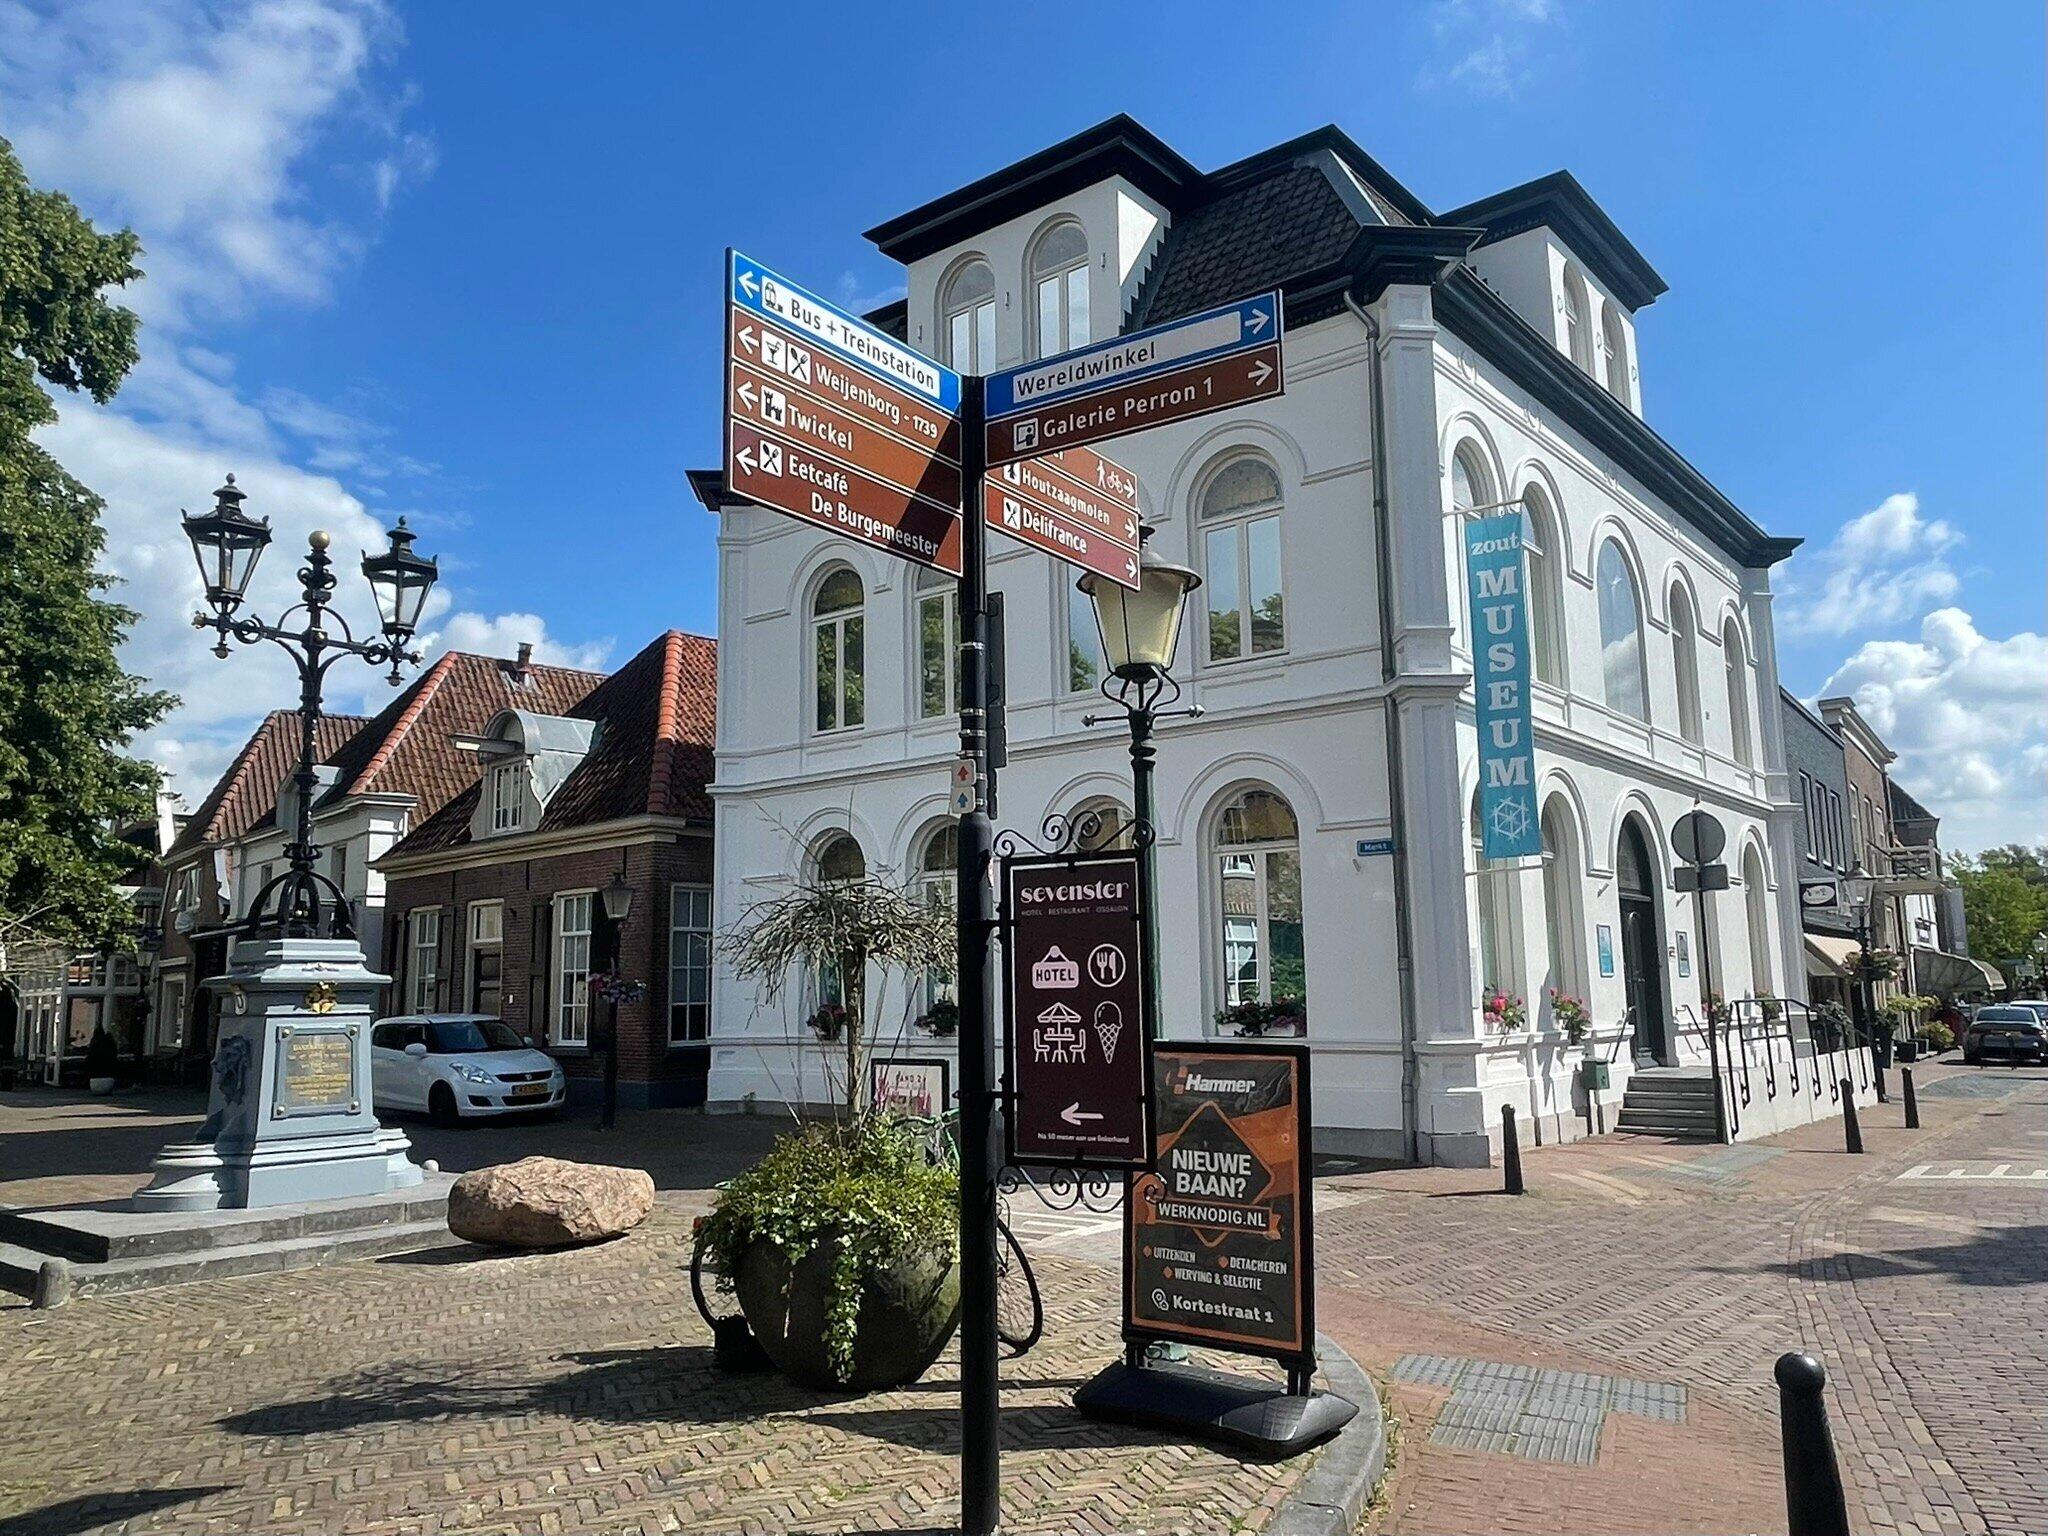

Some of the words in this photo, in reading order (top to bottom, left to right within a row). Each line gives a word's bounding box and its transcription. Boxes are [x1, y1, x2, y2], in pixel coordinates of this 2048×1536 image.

[791, 299, 821, 330] Bus
[827, 320, 837, 335] +
[841, 325, 935, 390] Treinstation
[1017, 342, 1156, 396] Wereldwinkel
[815, 362, 901, 425] Weijenborg
[912, 417, 938, 438] 1739
[1043, 406, 1117, 438] Galerie
[1124, 386, 1196, 418] Perron
[1203, 376, 1214, 396] 1
[787, 403, 853, 451] Twickel
[789, 454, 849, 496] Eetcafé
[1022, 467, 1111, 526] Houtzaagmolen
[811, 492, 832, 518] De
[838, 508, 939, 557] Burgemeester
[1023, 508, 1088, 554] Délifrance
[1470, 531, 1521, 556] zout
[1475, 565, 1530, 789] MUSEUM
[1020, 880, 1130, 904] sevenster
[1036, 968, 1075, 982] HOTEL
[1185, 1073, 1256, 1094] Hammer
[1172, 1148, 1251, 1176] NIEUWE
[1175, 1171, 1247, 1199] BAAN?
[1158, 1202, 1267, 1228] WERKNODIG.NL
[1153, 1246, 1196, 1264] UITZENDEN
[1229, 1256, 1288, 1276] DETACHEREN
[1174, 1267, 1213, 1285] WERVING
[1214, 1273, 1221, 1286] &
[1222, 1274, 1263, 1292] SELECTIE
[1172, 1294, 1261, 1322] Kortestraat
[1264, 1310, 1275, 1324] 1
